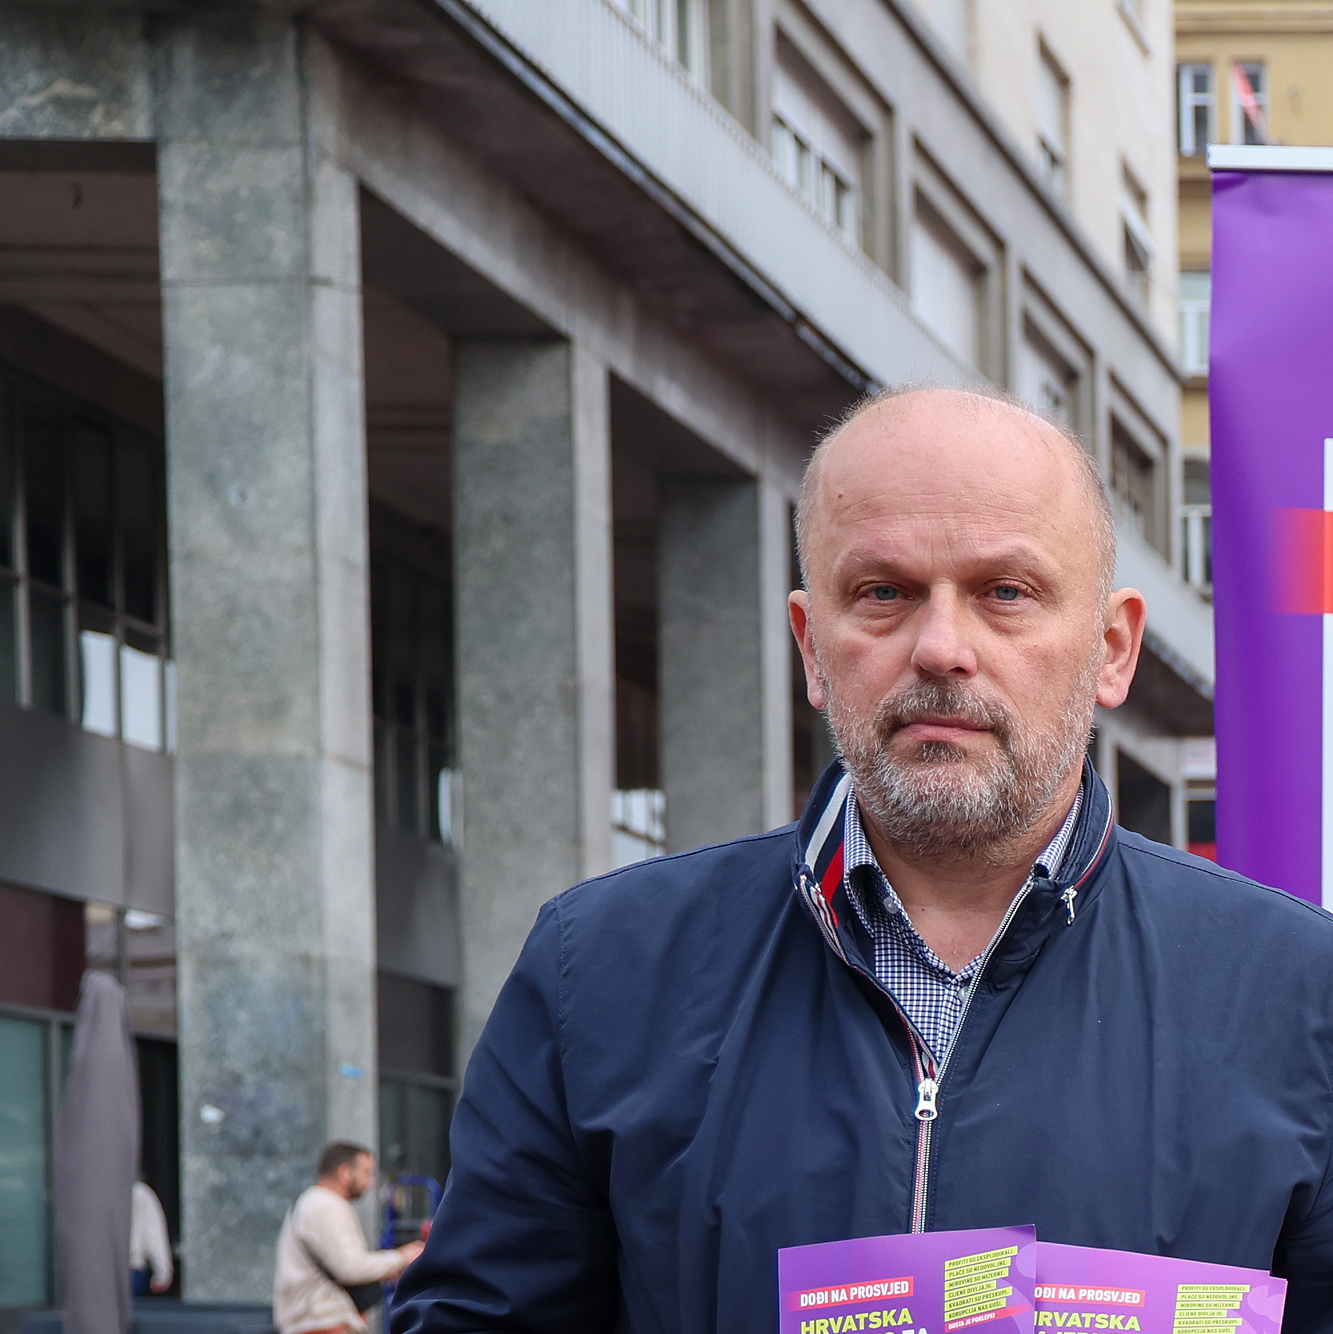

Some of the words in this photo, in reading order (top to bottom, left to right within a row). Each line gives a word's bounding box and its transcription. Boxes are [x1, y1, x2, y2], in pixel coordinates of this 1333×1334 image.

[801, 1291, 828, 1307] DOĐI
[831, 1288, 847, 1303] NA
[850, 1280, 909, 1300] PROSVJED
[1034, 1286, 1056, 1299] OĐI
[1058, 1288, 1077, 1299] NA
[1078, 1289, 1141, 1304] PROSVJED
[1034, 1311, 1141, 1331] RVATSKA
